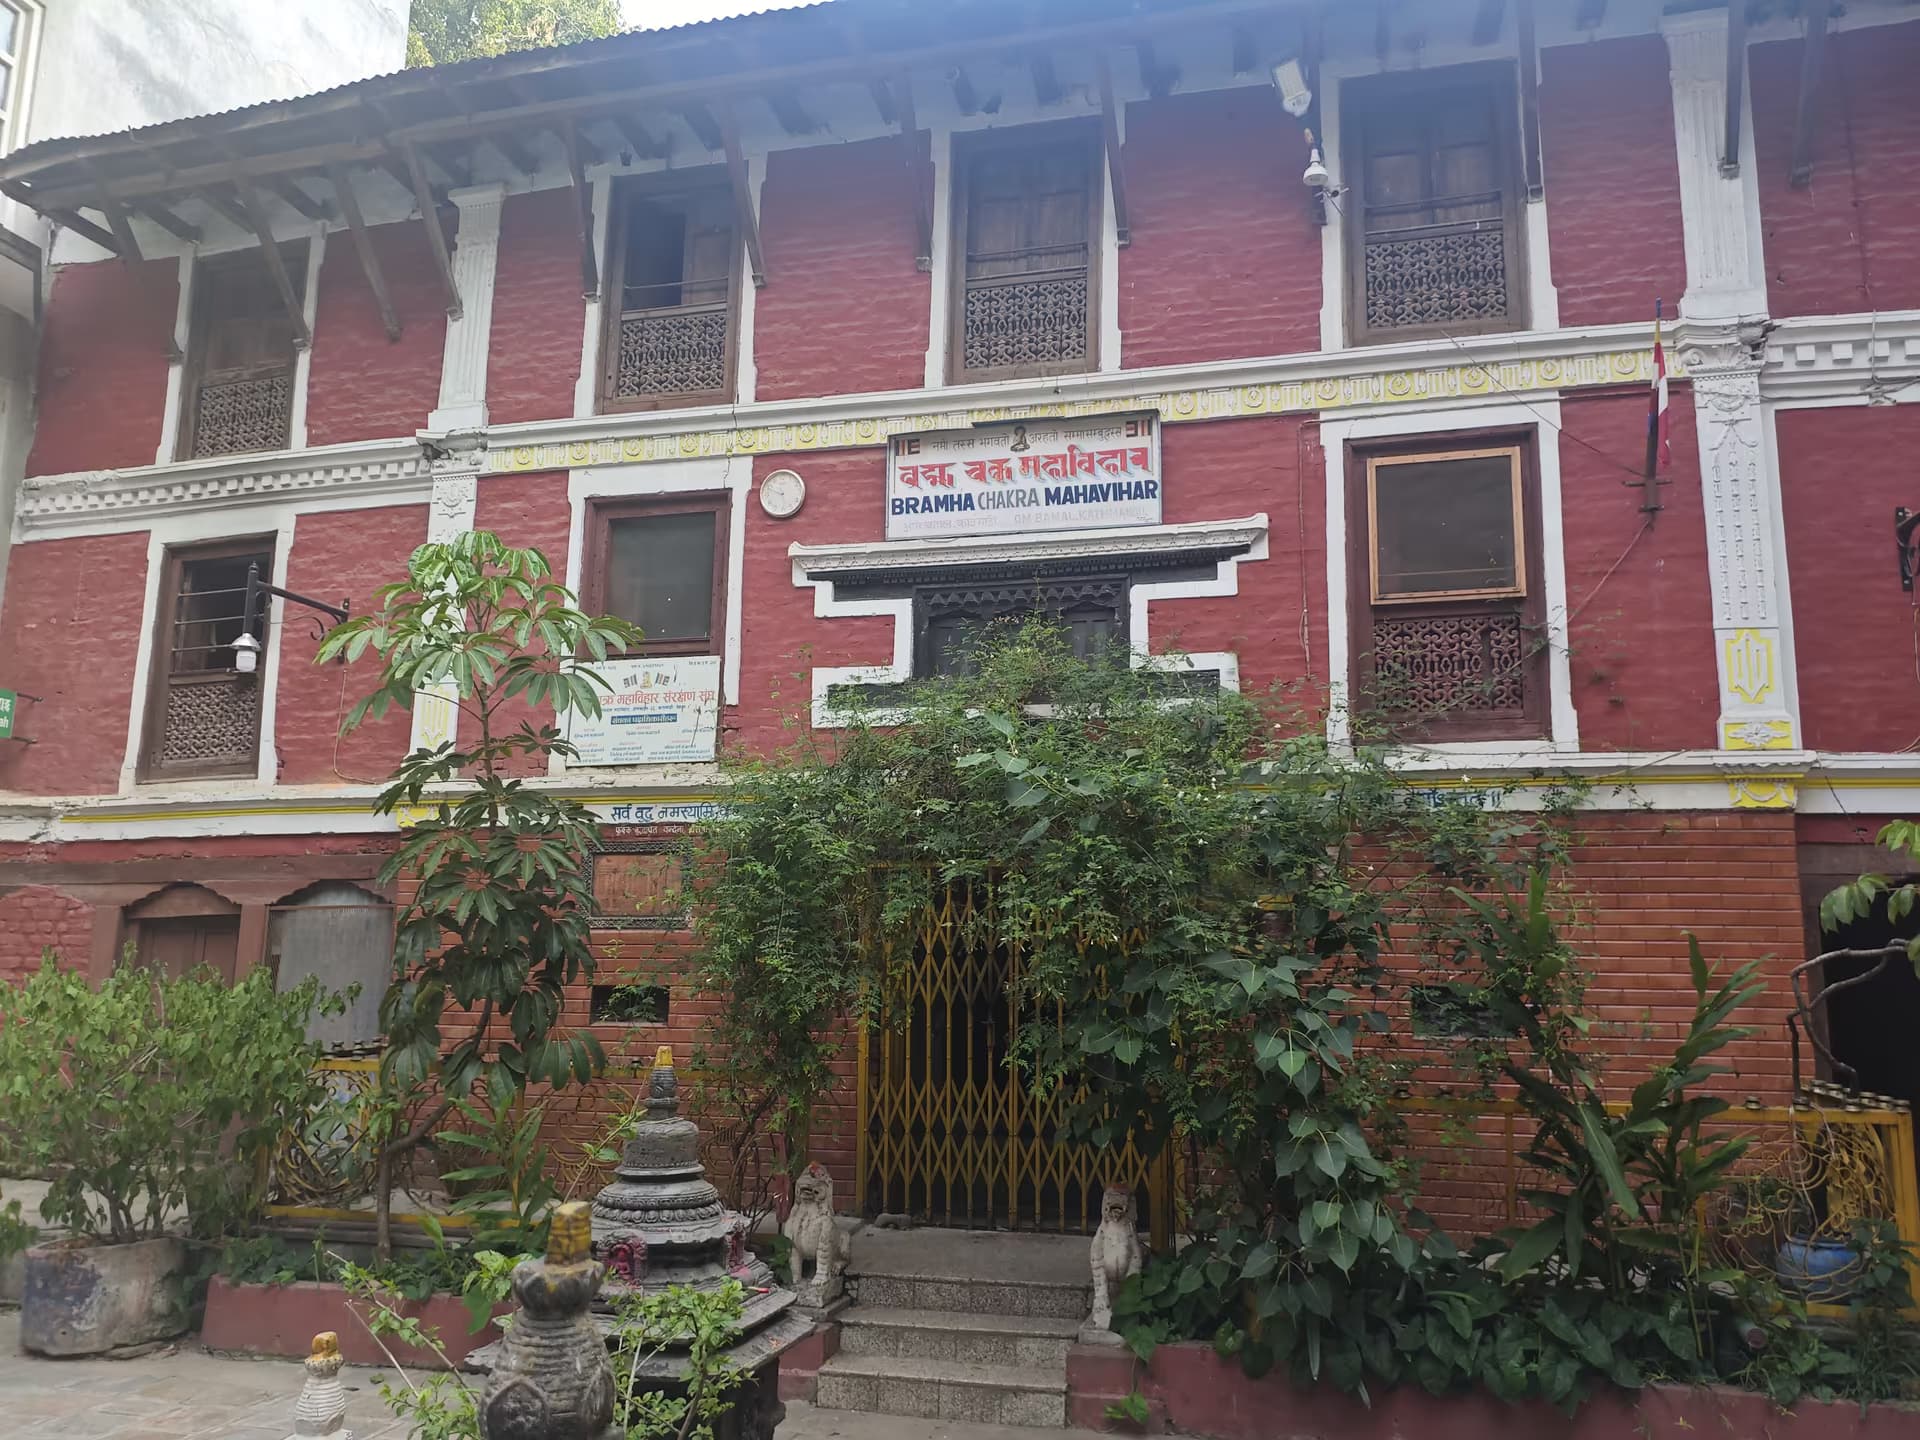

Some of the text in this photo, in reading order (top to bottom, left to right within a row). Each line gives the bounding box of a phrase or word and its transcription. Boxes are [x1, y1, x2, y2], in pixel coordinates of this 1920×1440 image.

[891, 480, 1159, 516] BRAMHA CHAKRA MAHAVIHAR
[616, 690, 659, 706] महाविहार
